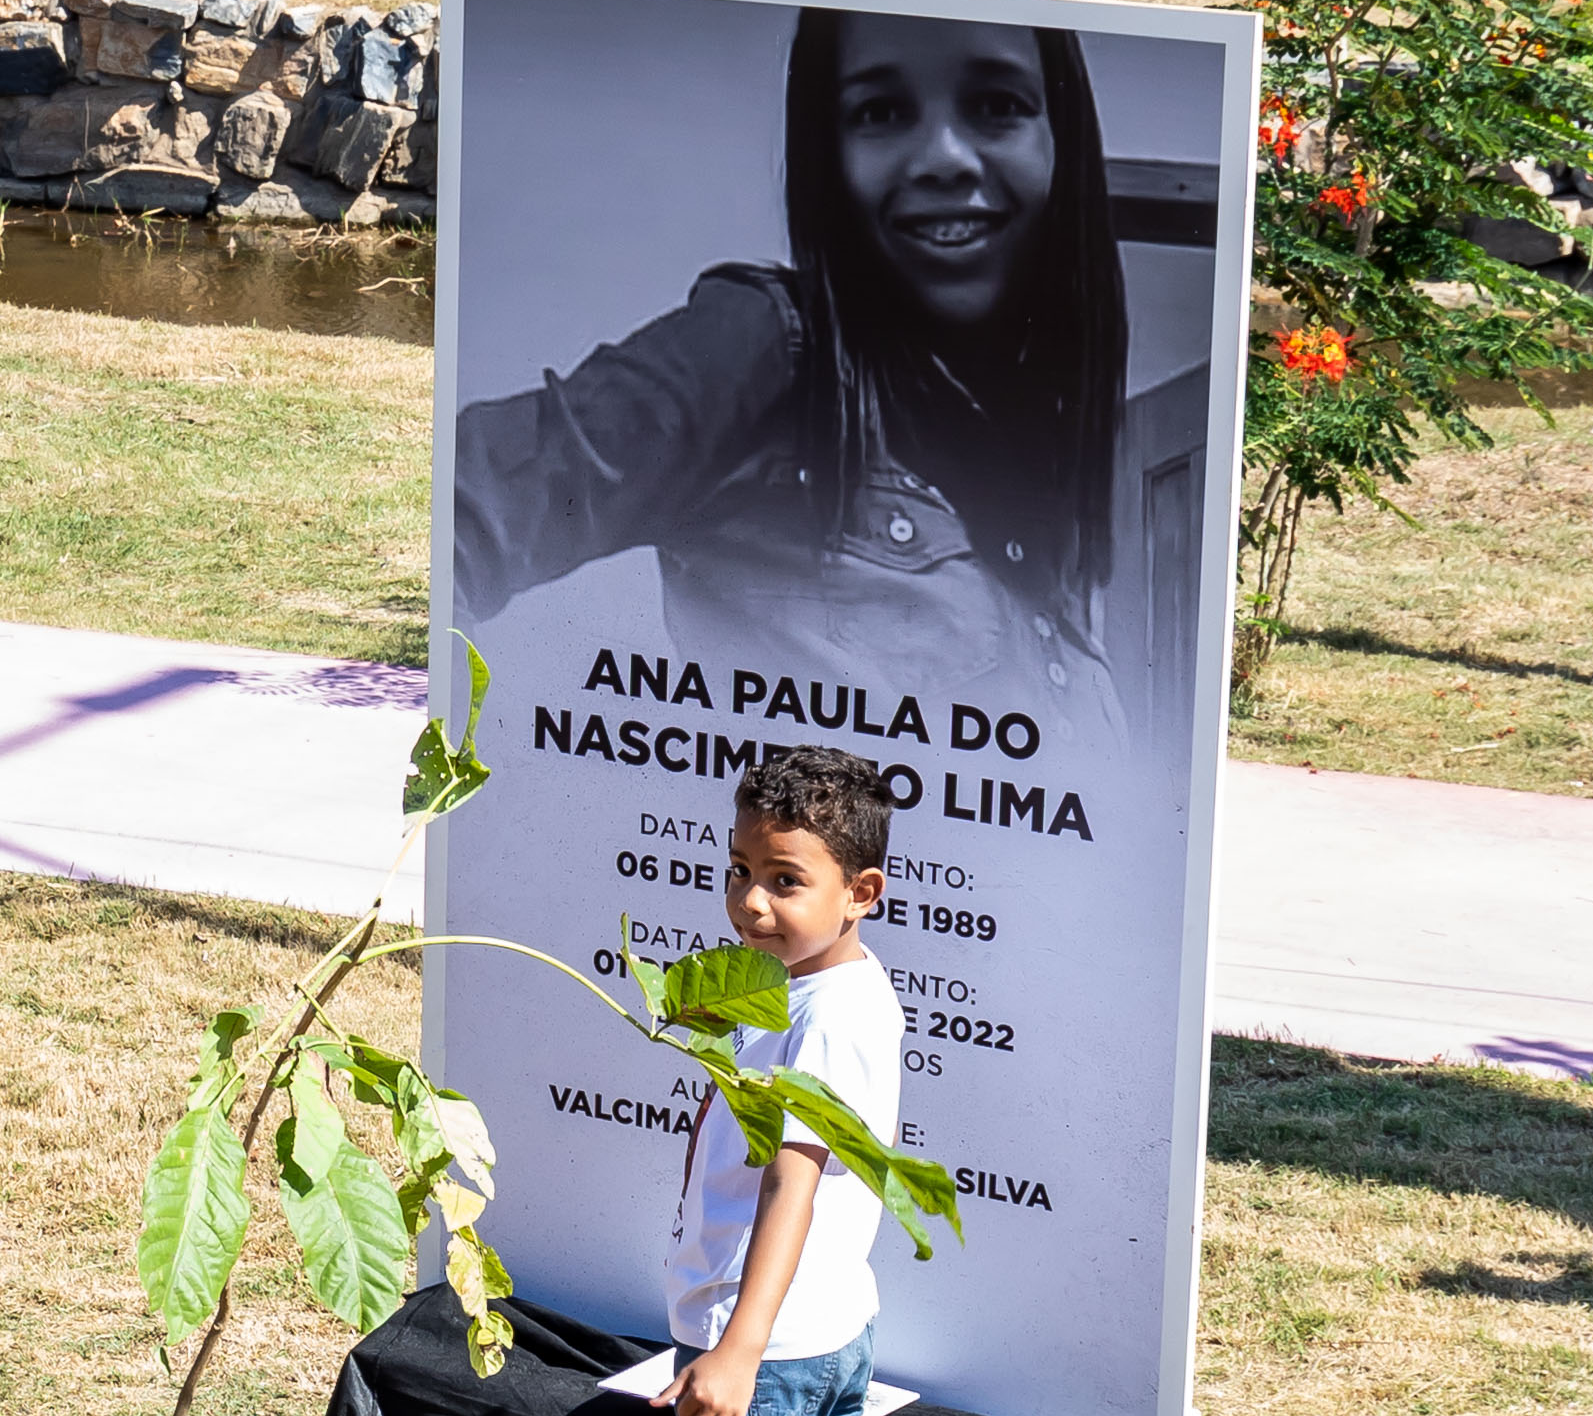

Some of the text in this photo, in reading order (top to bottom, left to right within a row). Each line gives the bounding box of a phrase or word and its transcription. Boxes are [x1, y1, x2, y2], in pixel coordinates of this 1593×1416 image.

[584, 648, 1041, 760] ANA PAULA DO
[533, 706, 1094, 842] NASCIMO LIMA
[640, 813, 718, 847] DATA
[616, 850, 659, 882] 06
[669, 859, 714, 892] DE
[918, 904, 997, 942] 1989
[631, 921, 707, 953] DATA
[593, 949, 627, 978] 01
[927, 1011, 1015, 1052] 2022
[955, 1167, 1053, 1212] SILVA
